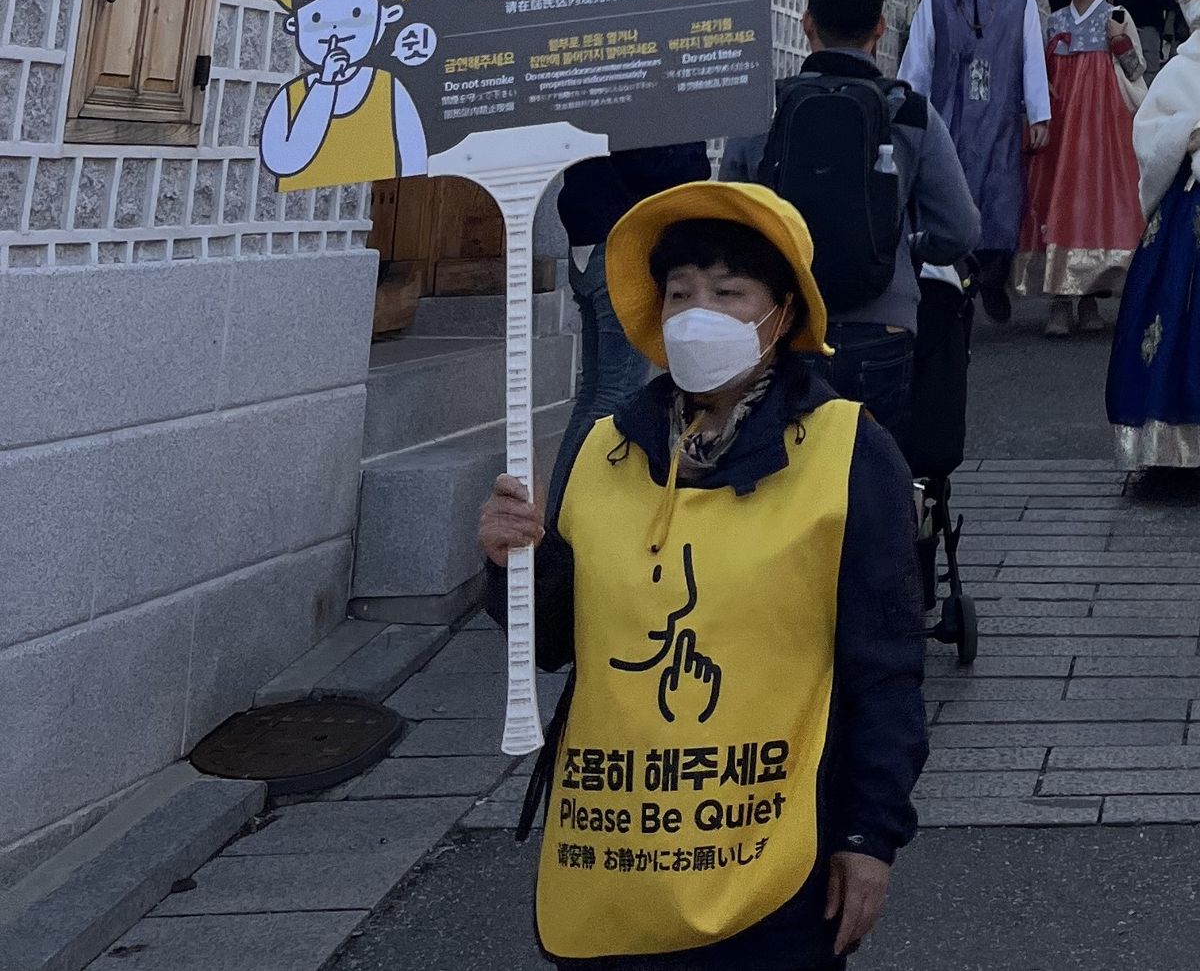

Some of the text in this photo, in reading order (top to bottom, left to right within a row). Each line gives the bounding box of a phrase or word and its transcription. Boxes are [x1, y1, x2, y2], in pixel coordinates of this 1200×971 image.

[403, 28, 429, 62] 쉿
[682, 53, 698, 65] Do
[445, 75, 515, 92] Do not smoke
[561, 739, 790, 793] 조용히 해주세요
[560, 791, 787, 834] Please Be Quiet
